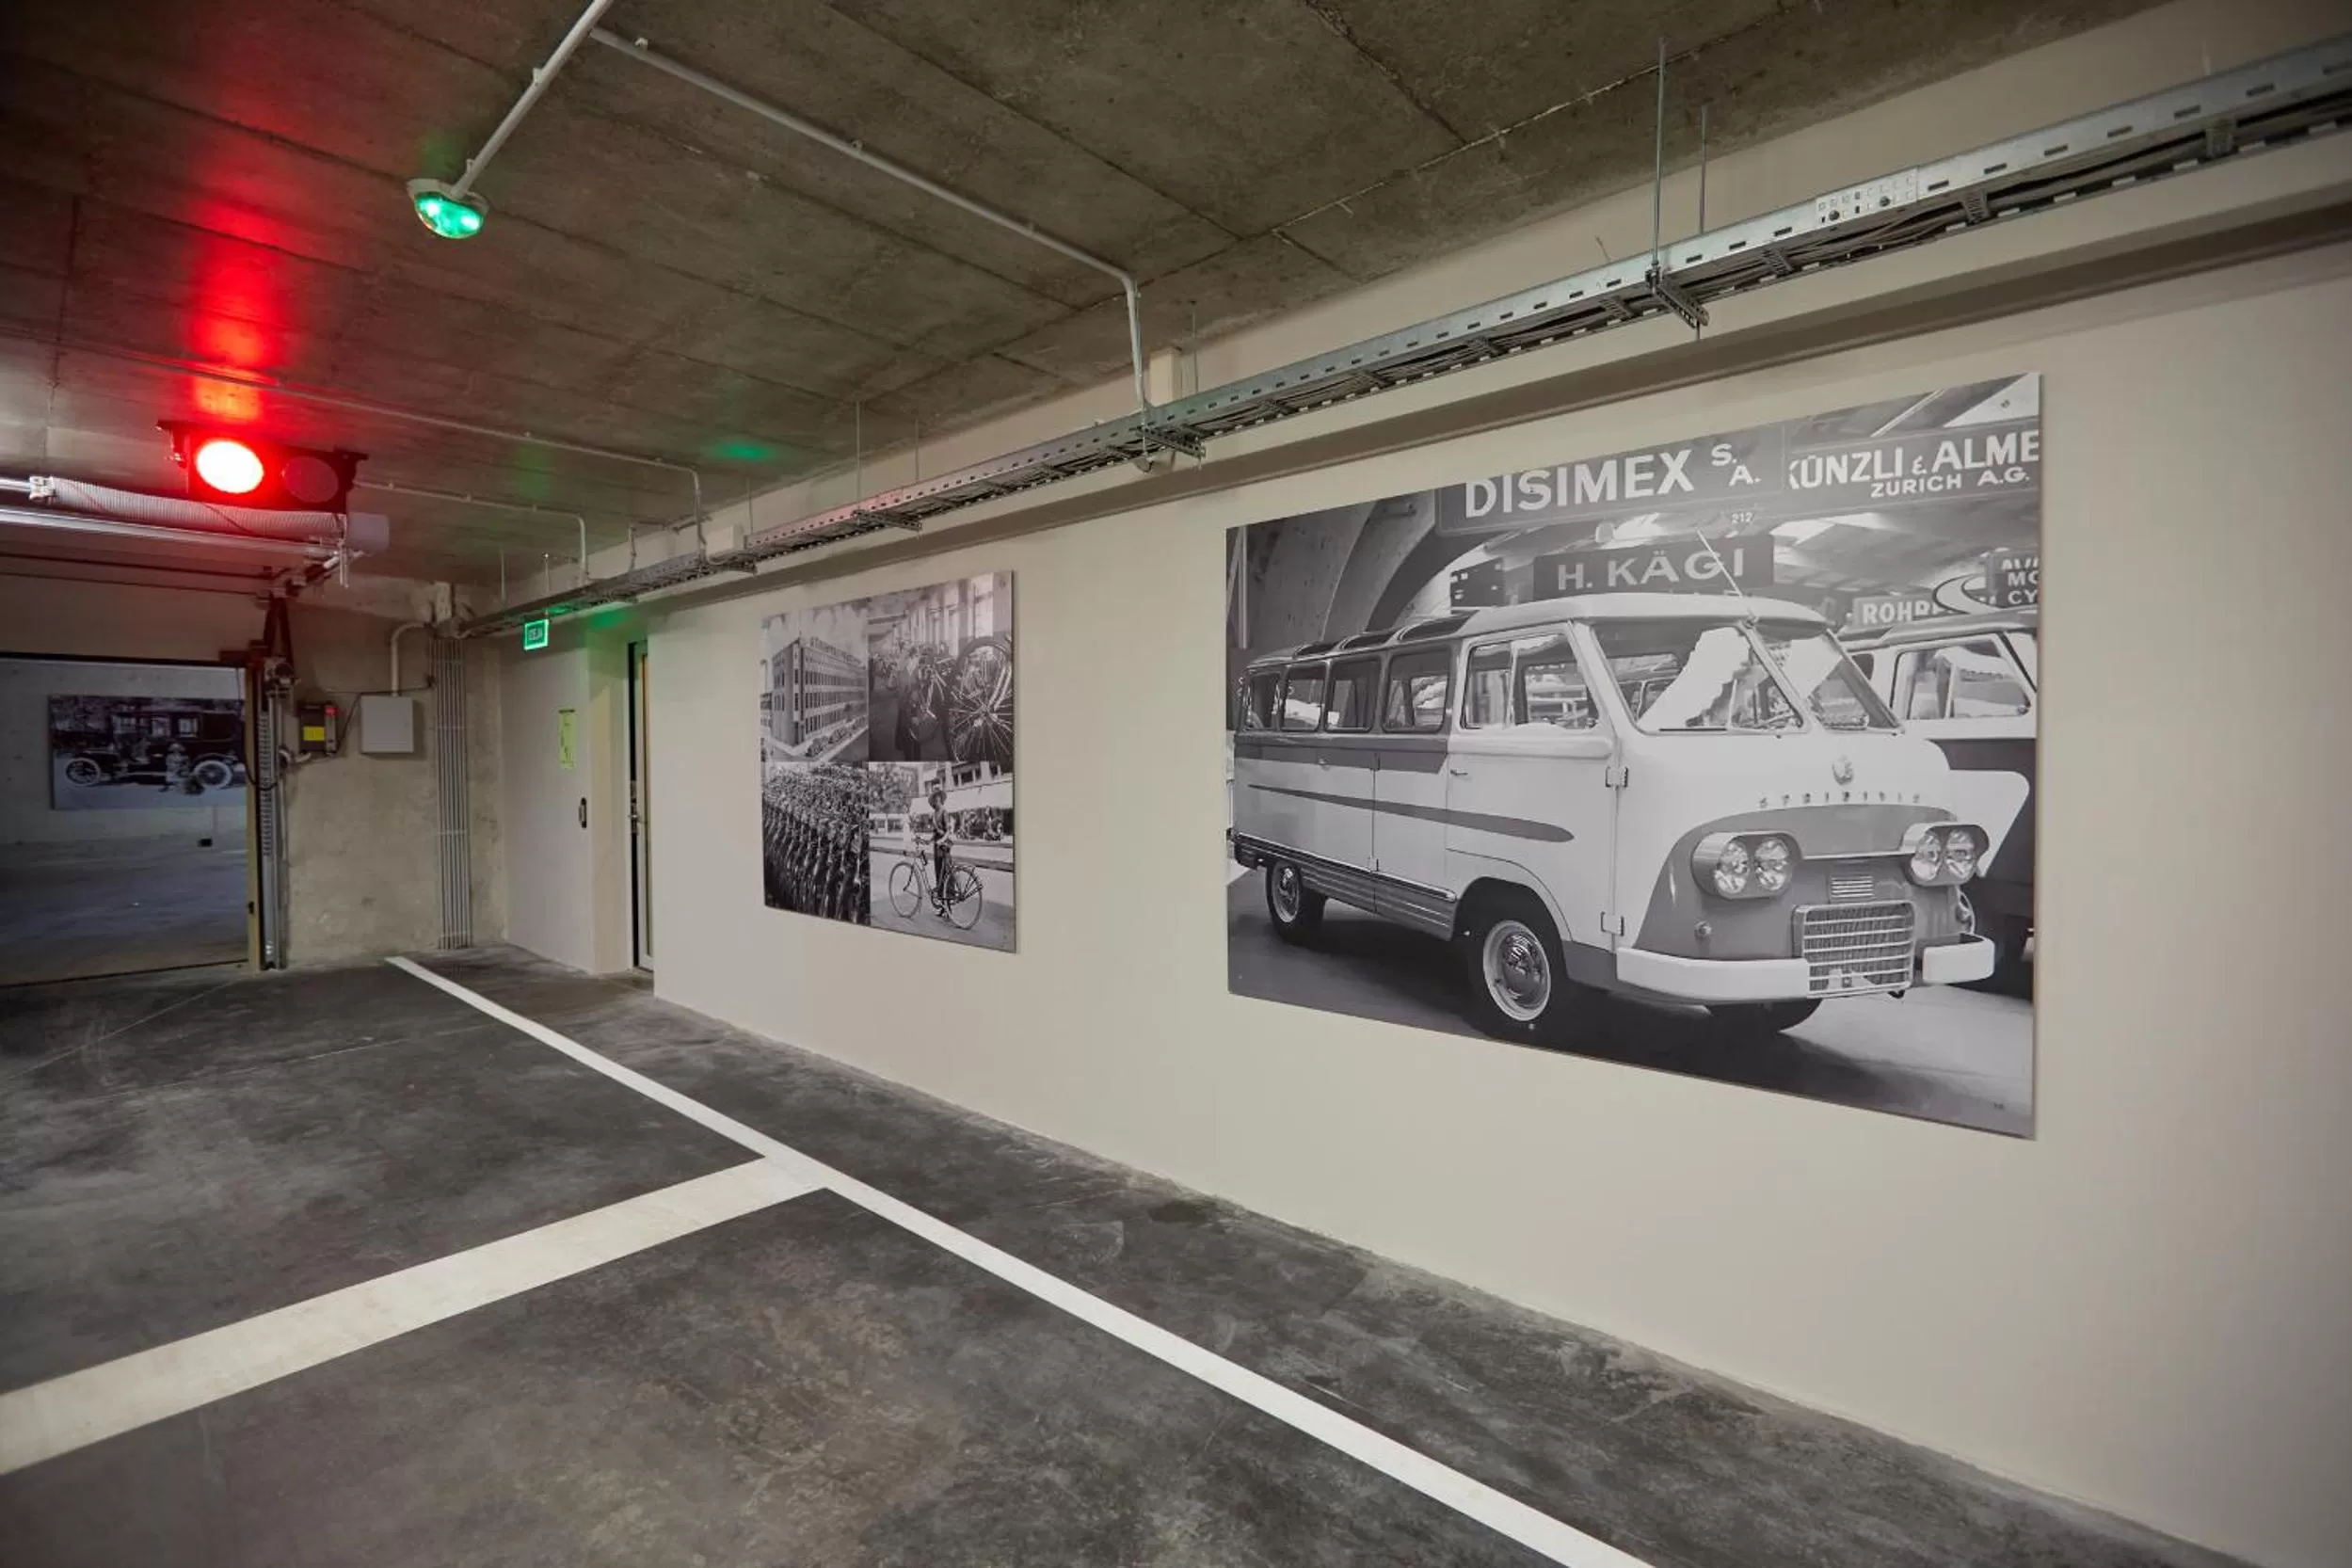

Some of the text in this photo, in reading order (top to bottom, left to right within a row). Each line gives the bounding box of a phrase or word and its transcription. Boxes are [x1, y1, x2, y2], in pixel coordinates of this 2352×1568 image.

[1931, 429, 2039, 472] ALME
[1465, 443, 1762, 518] DISIMEX S. A.
[1977, 467, 2030, 487] A.G.
[1558, 549, 1744, 590] H. KÄGI
